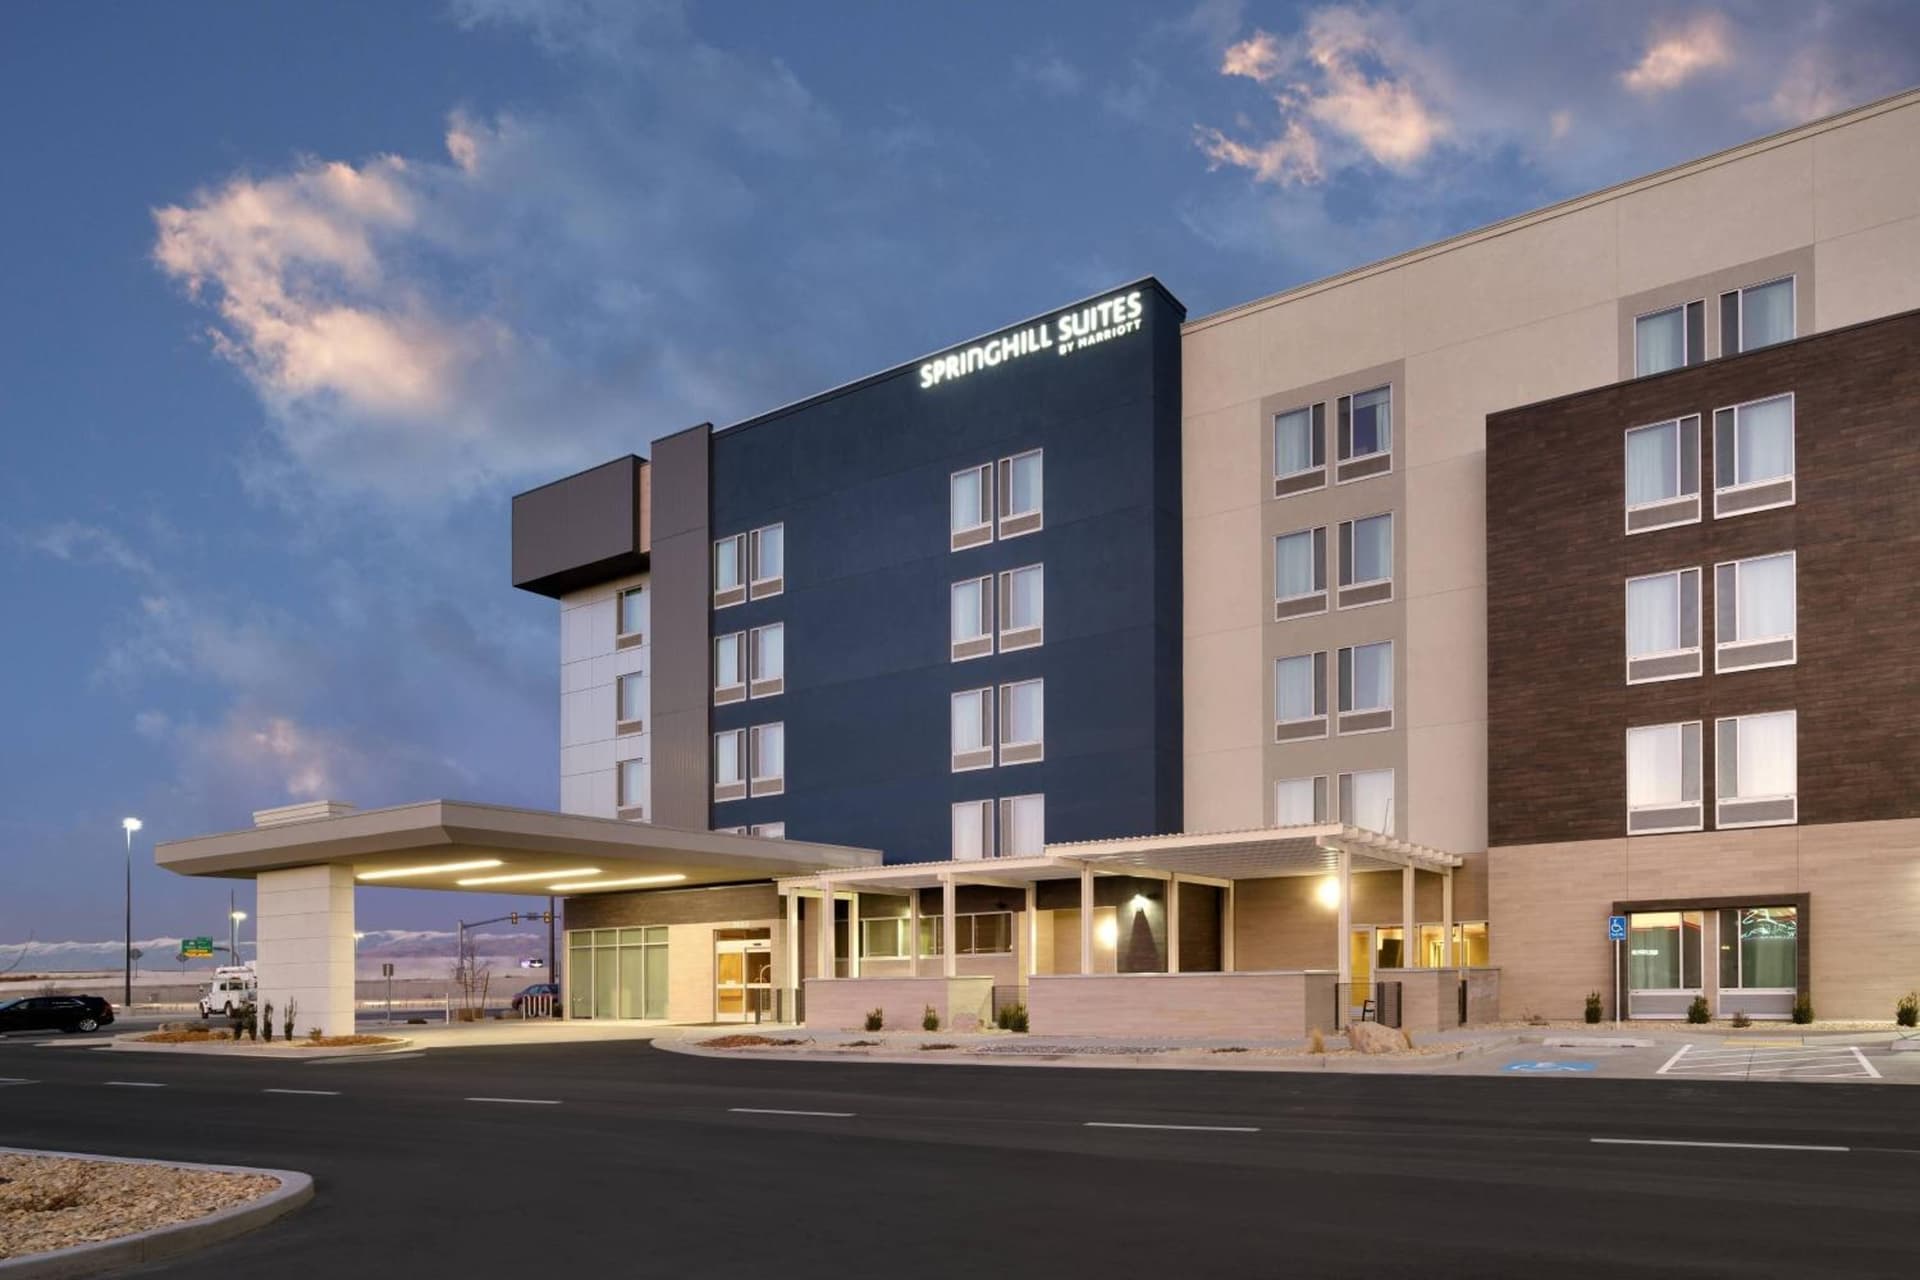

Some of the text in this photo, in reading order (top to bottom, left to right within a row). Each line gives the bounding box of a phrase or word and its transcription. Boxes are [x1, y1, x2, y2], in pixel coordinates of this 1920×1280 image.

[920, 292, 1143, 389] SPRINGHILL SUITES
[1058, 319, 1142, 356] BY MARRIOTT
